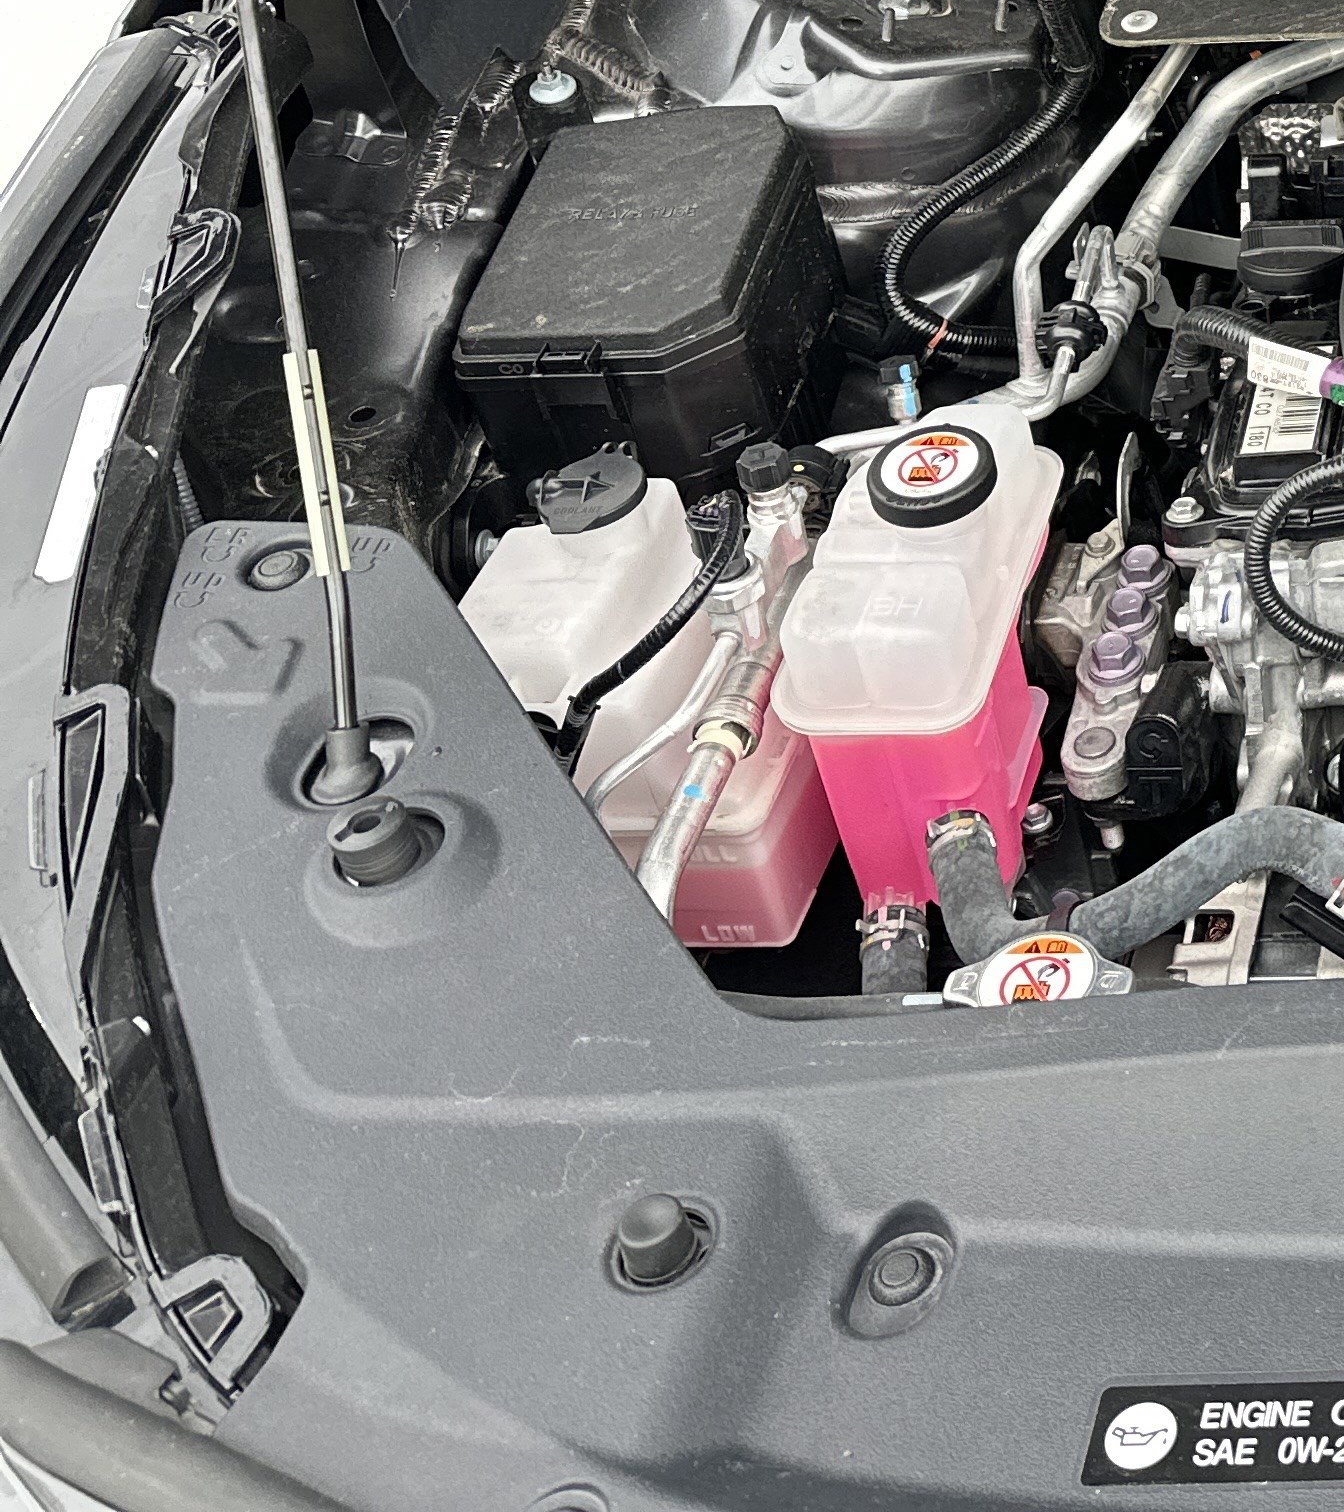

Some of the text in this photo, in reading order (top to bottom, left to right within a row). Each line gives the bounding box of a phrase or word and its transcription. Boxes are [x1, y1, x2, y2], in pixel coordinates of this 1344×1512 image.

[700, 925, 755, 942] LOW
[1199, 1399, 1314, 1429] ENGINE
[1192, 1437, 1258, 1467] SAE
